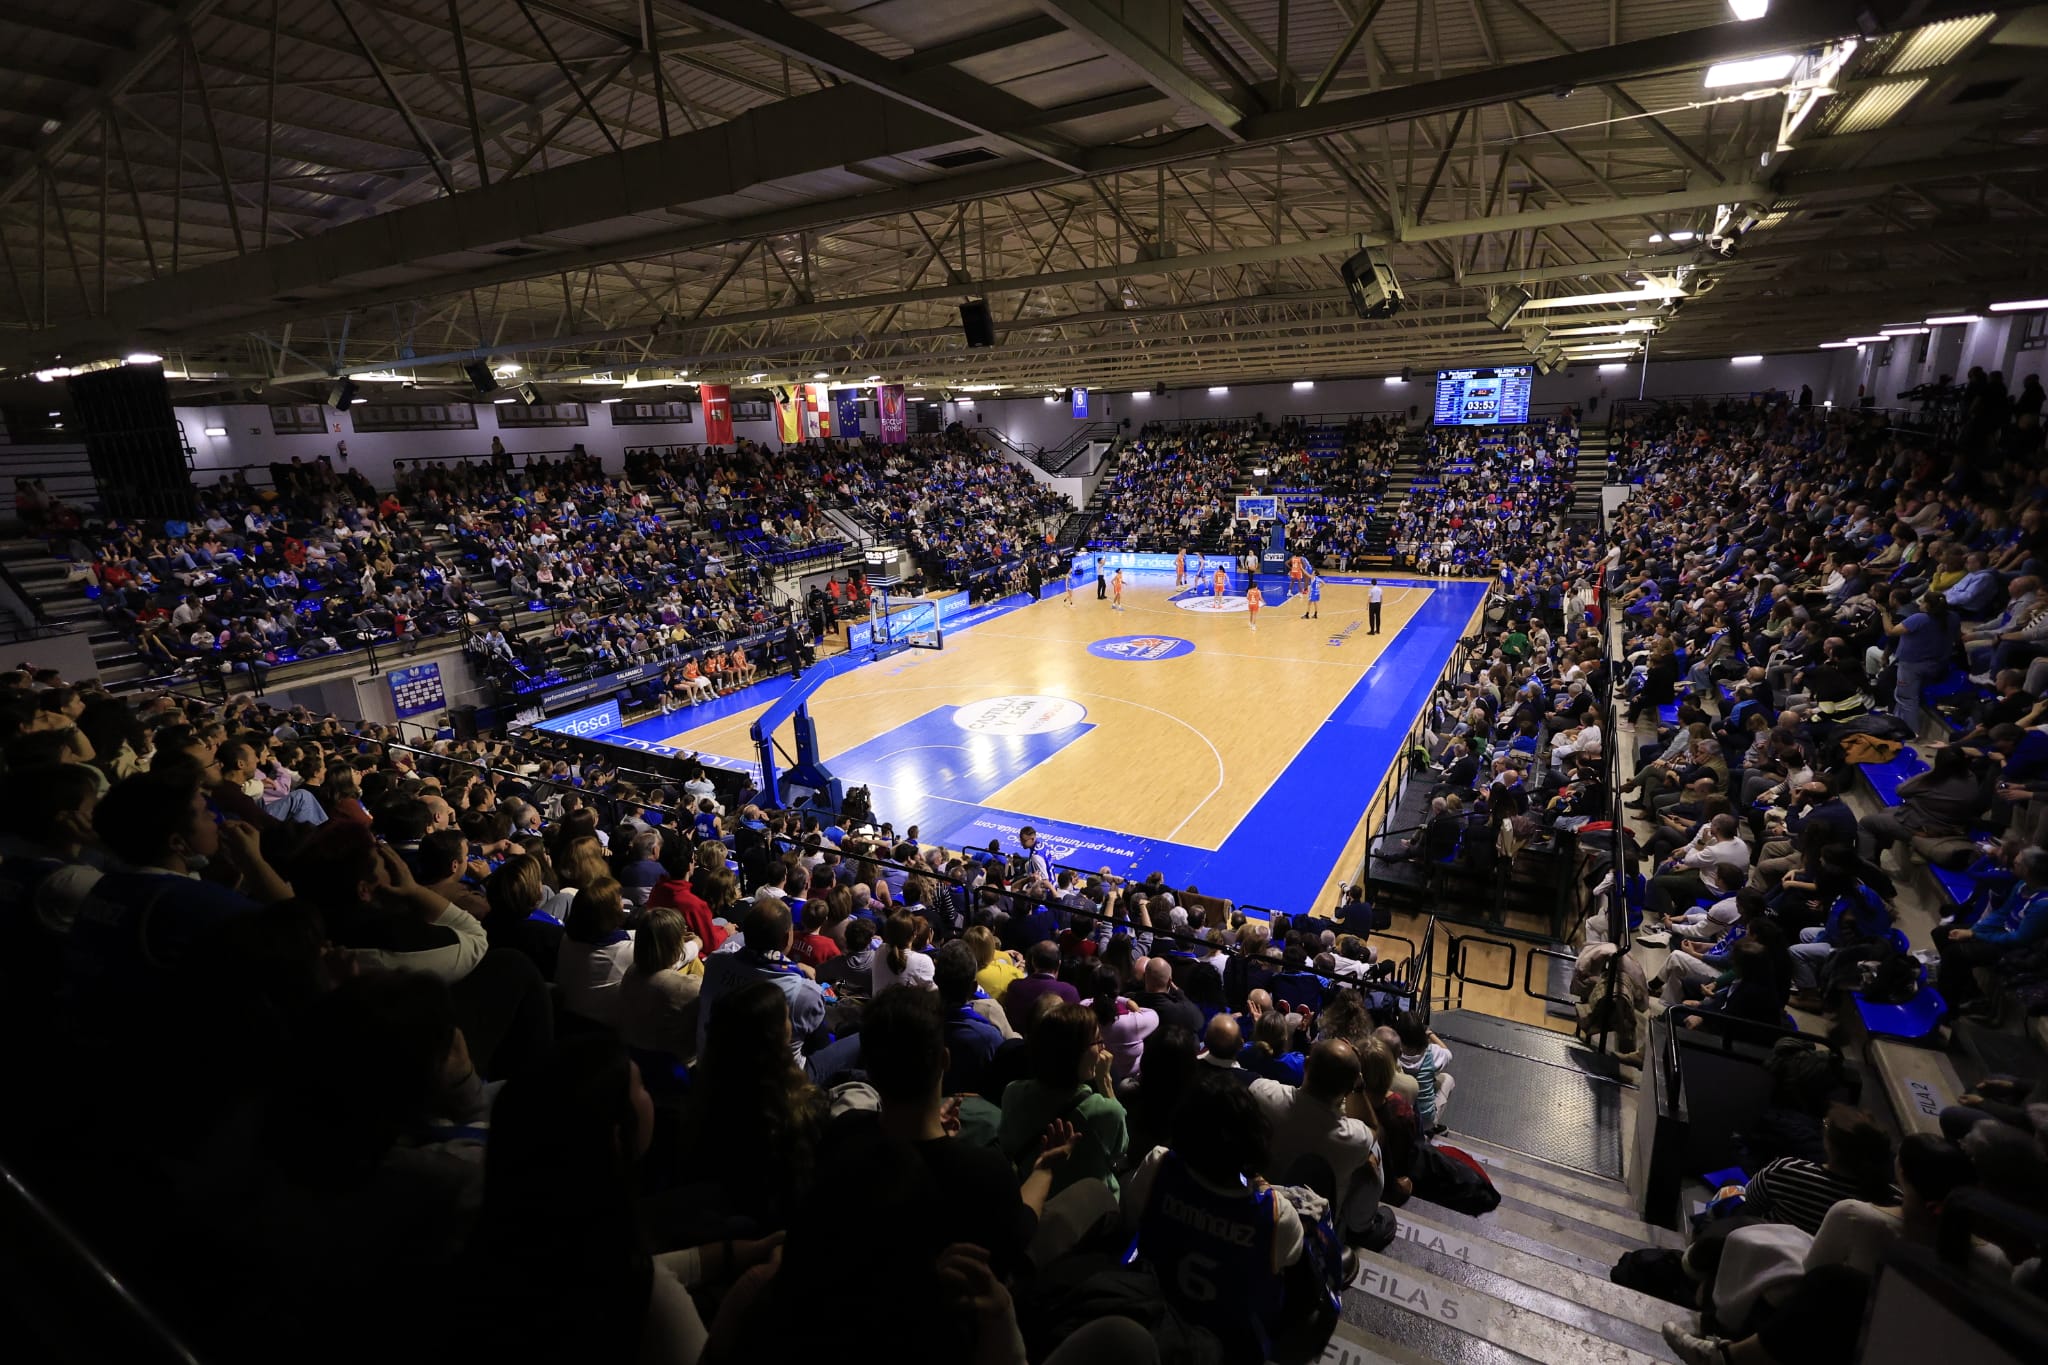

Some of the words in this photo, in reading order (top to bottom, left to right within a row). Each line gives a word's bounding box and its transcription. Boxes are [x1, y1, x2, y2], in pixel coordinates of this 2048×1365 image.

[1467, 401, 1494, 410] 03:53
[944, 599, 967, 612] endesa
[616, 668, 644, 681] SALAMANCA
[1915, 1092, 1941, 1117] FILA
[1396, 1222, 1447, 1255] FILA
[1454, 1246, 1470, 1261] 4
[1177, 1251, 1220, 1302] 6
[1360, 1268, 1430, 1311] FILA
[1440, 1301, 1460, 1320] 5
